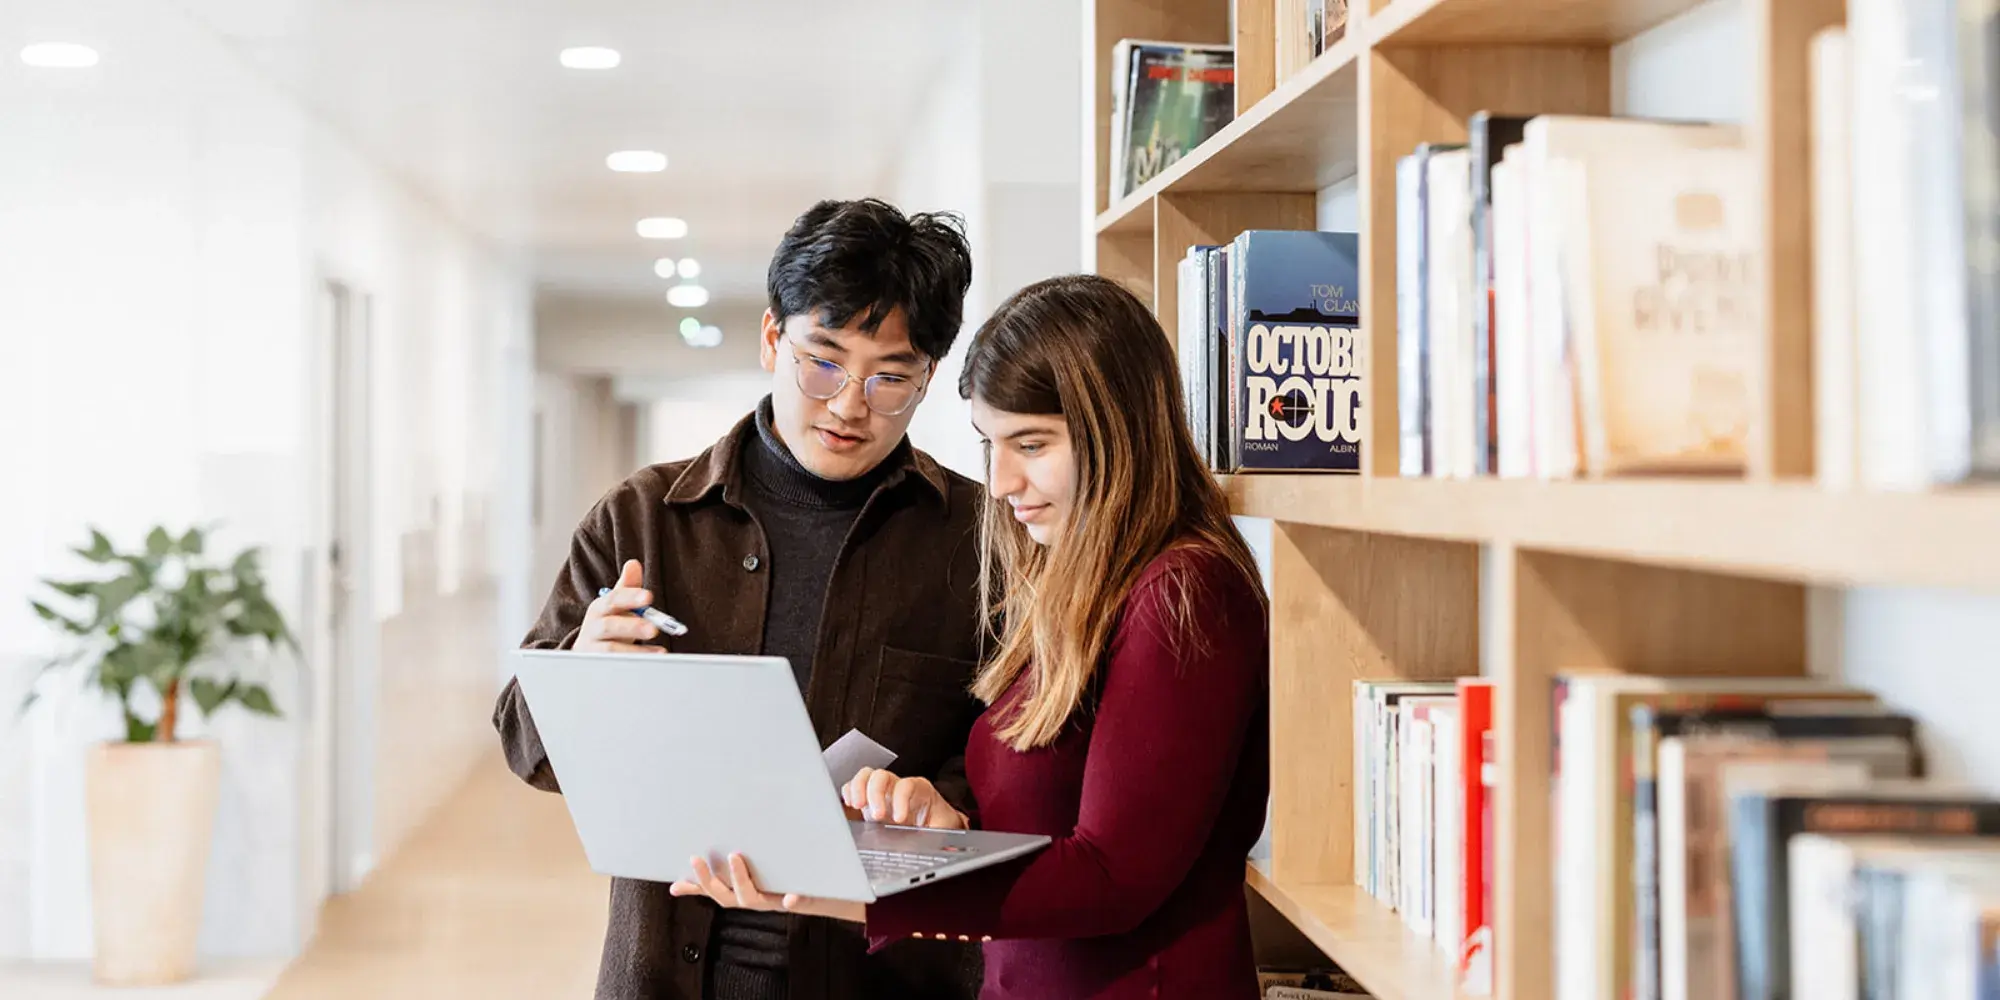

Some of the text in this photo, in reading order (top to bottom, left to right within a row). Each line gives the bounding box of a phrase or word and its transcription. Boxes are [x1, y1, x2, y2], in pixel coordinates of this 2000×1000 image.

[1310, 284, 1343, 298] TOM
[1245, 376, 1362, 443] ROUG
[1245, 442, 1279, 451] ROMAN
[1329, 445, 1357, 454] ALBIN
